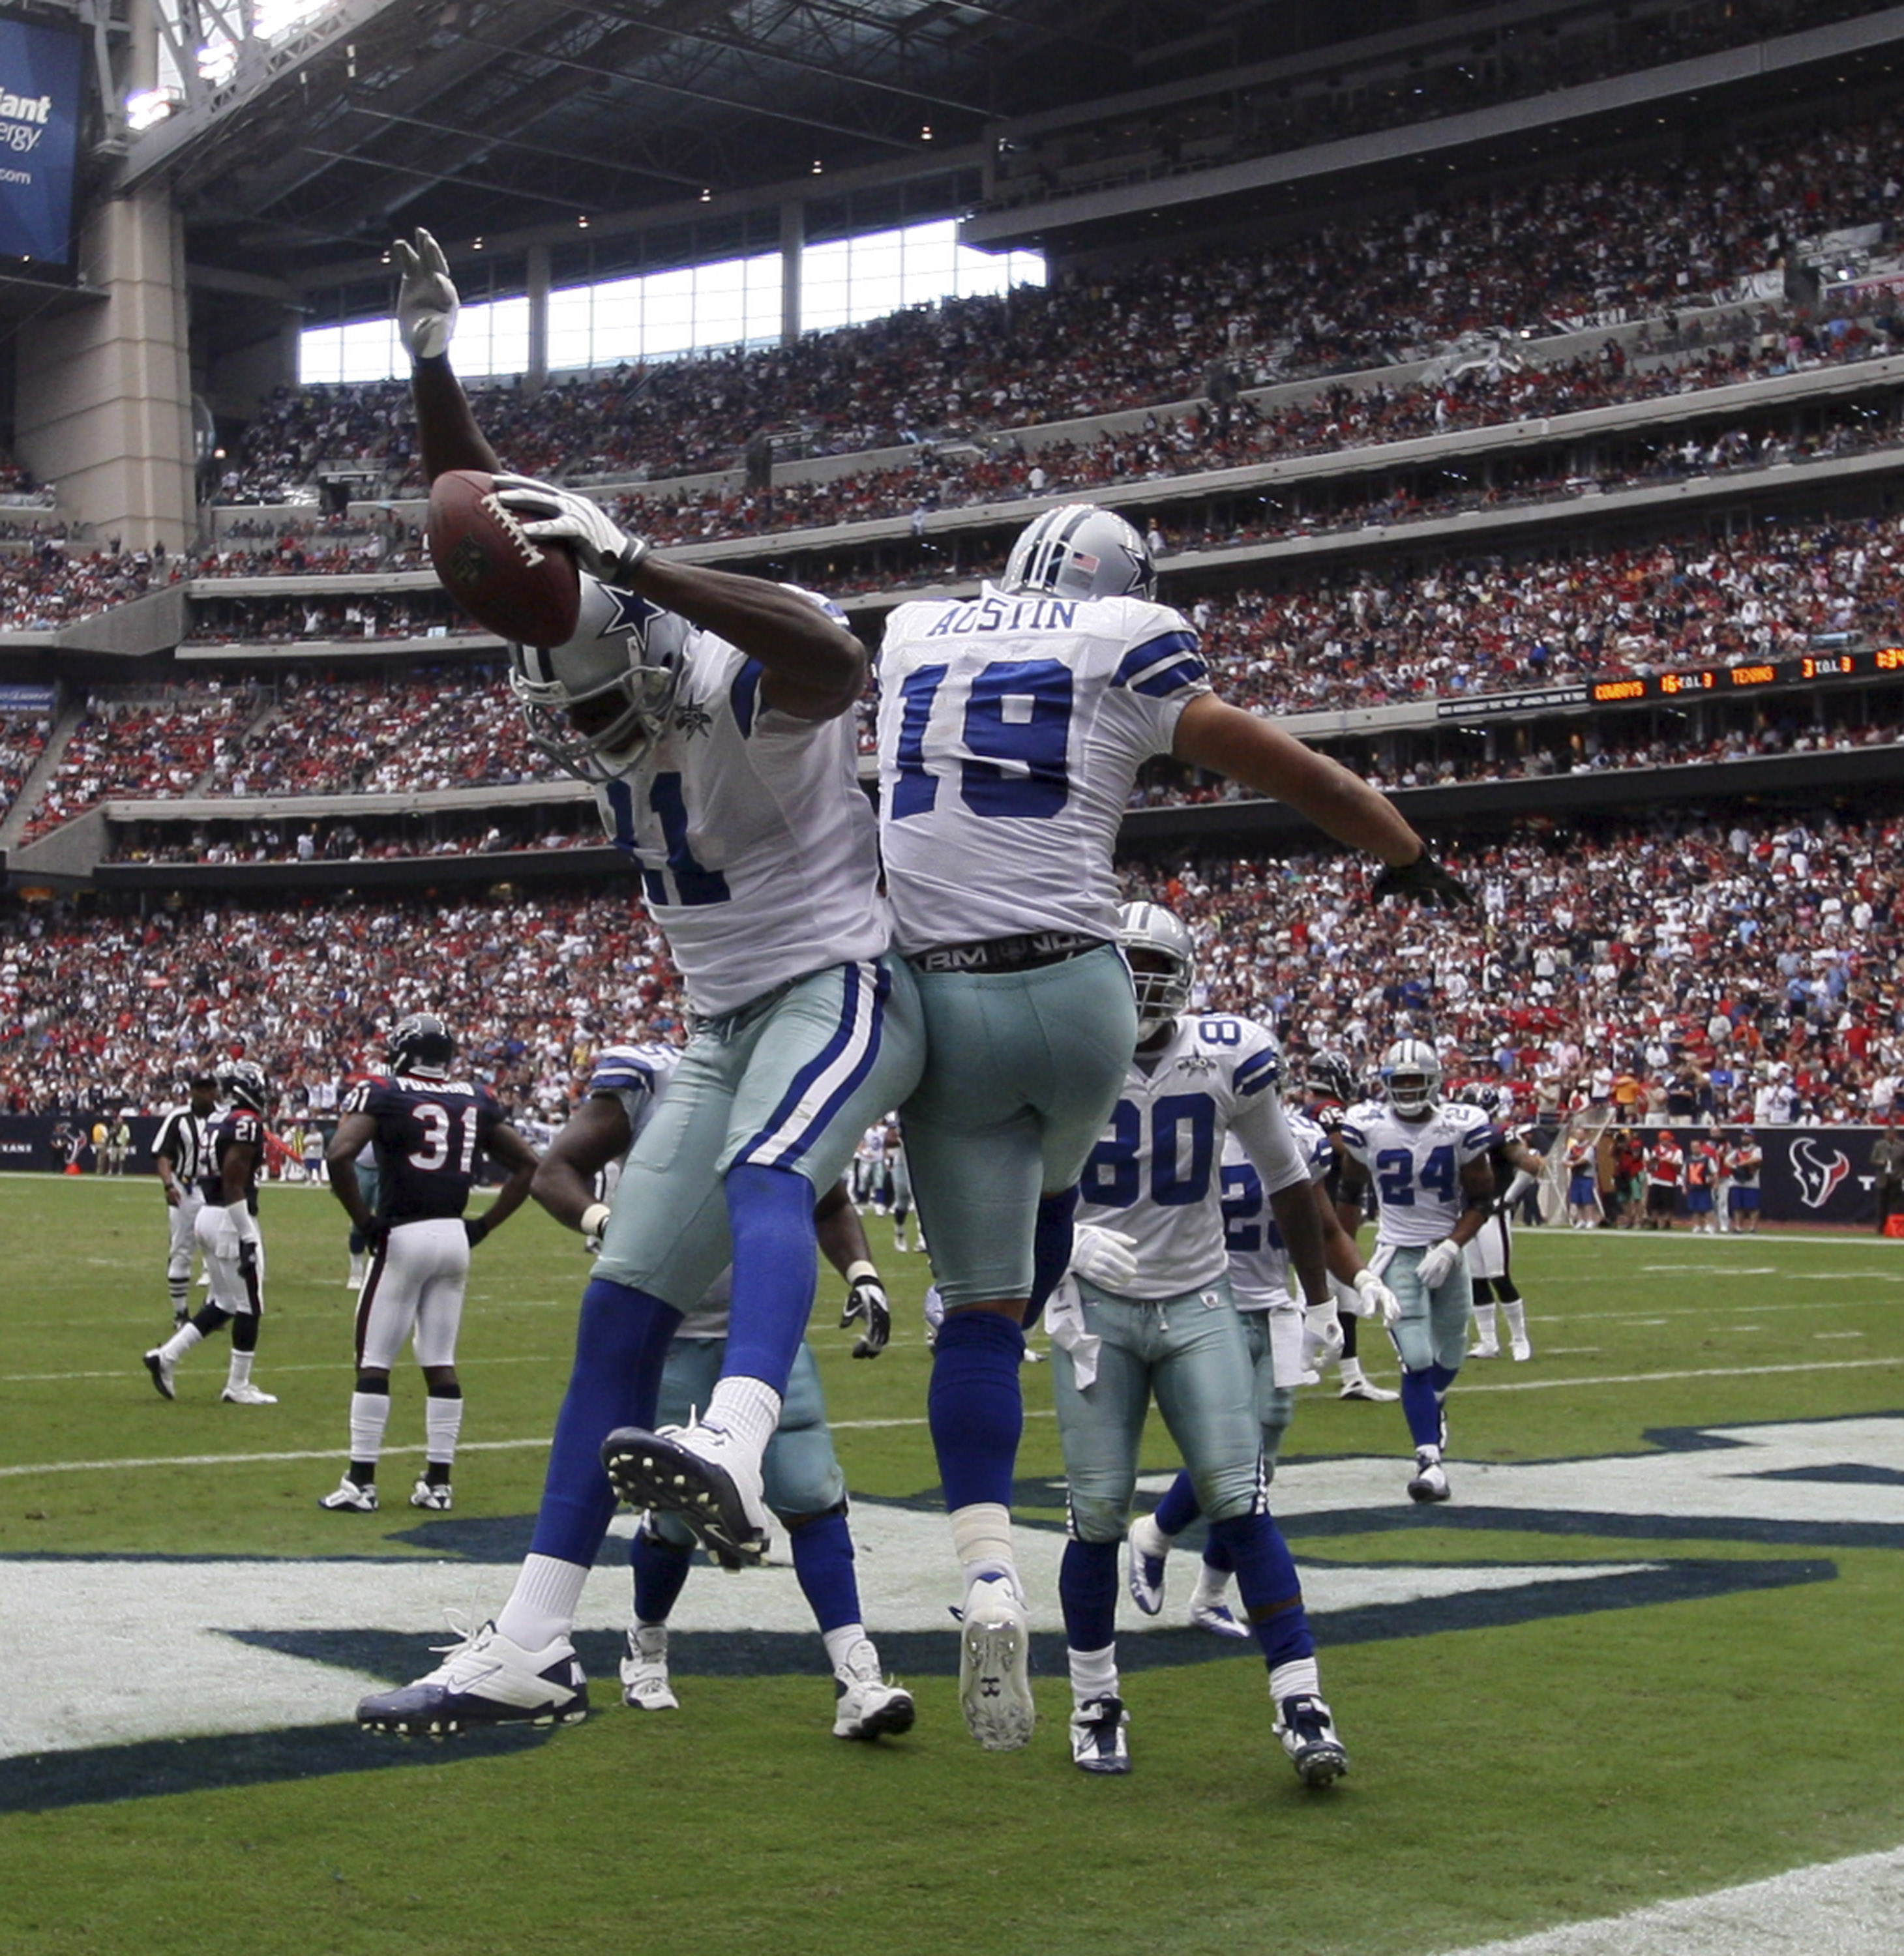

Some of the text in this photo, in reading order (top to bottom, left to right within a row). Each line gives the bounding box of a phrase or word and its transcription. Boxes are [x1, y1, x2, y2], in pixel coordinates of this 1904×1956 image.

[926, 597, 1080, 637] AUSTIN
[1594, 680, 1644, 701] COWBOYS
[1662, 673, 1678, 694] 16
[1731, 664, 1774, 685] TEXANS
[1802, 658, 1814, 679] 3
[891, 657, 1074, 821] 19
[606, 771, 732, 906] 11
[395, 1076, 475, 1097] POLLARD
[235, 1120, 258, 1142] 21
[408, 1103, 479, 1174] 31
[1080, 1091, 1216, 1209] 80
[1376, 1144, 1456, 1206] 24
